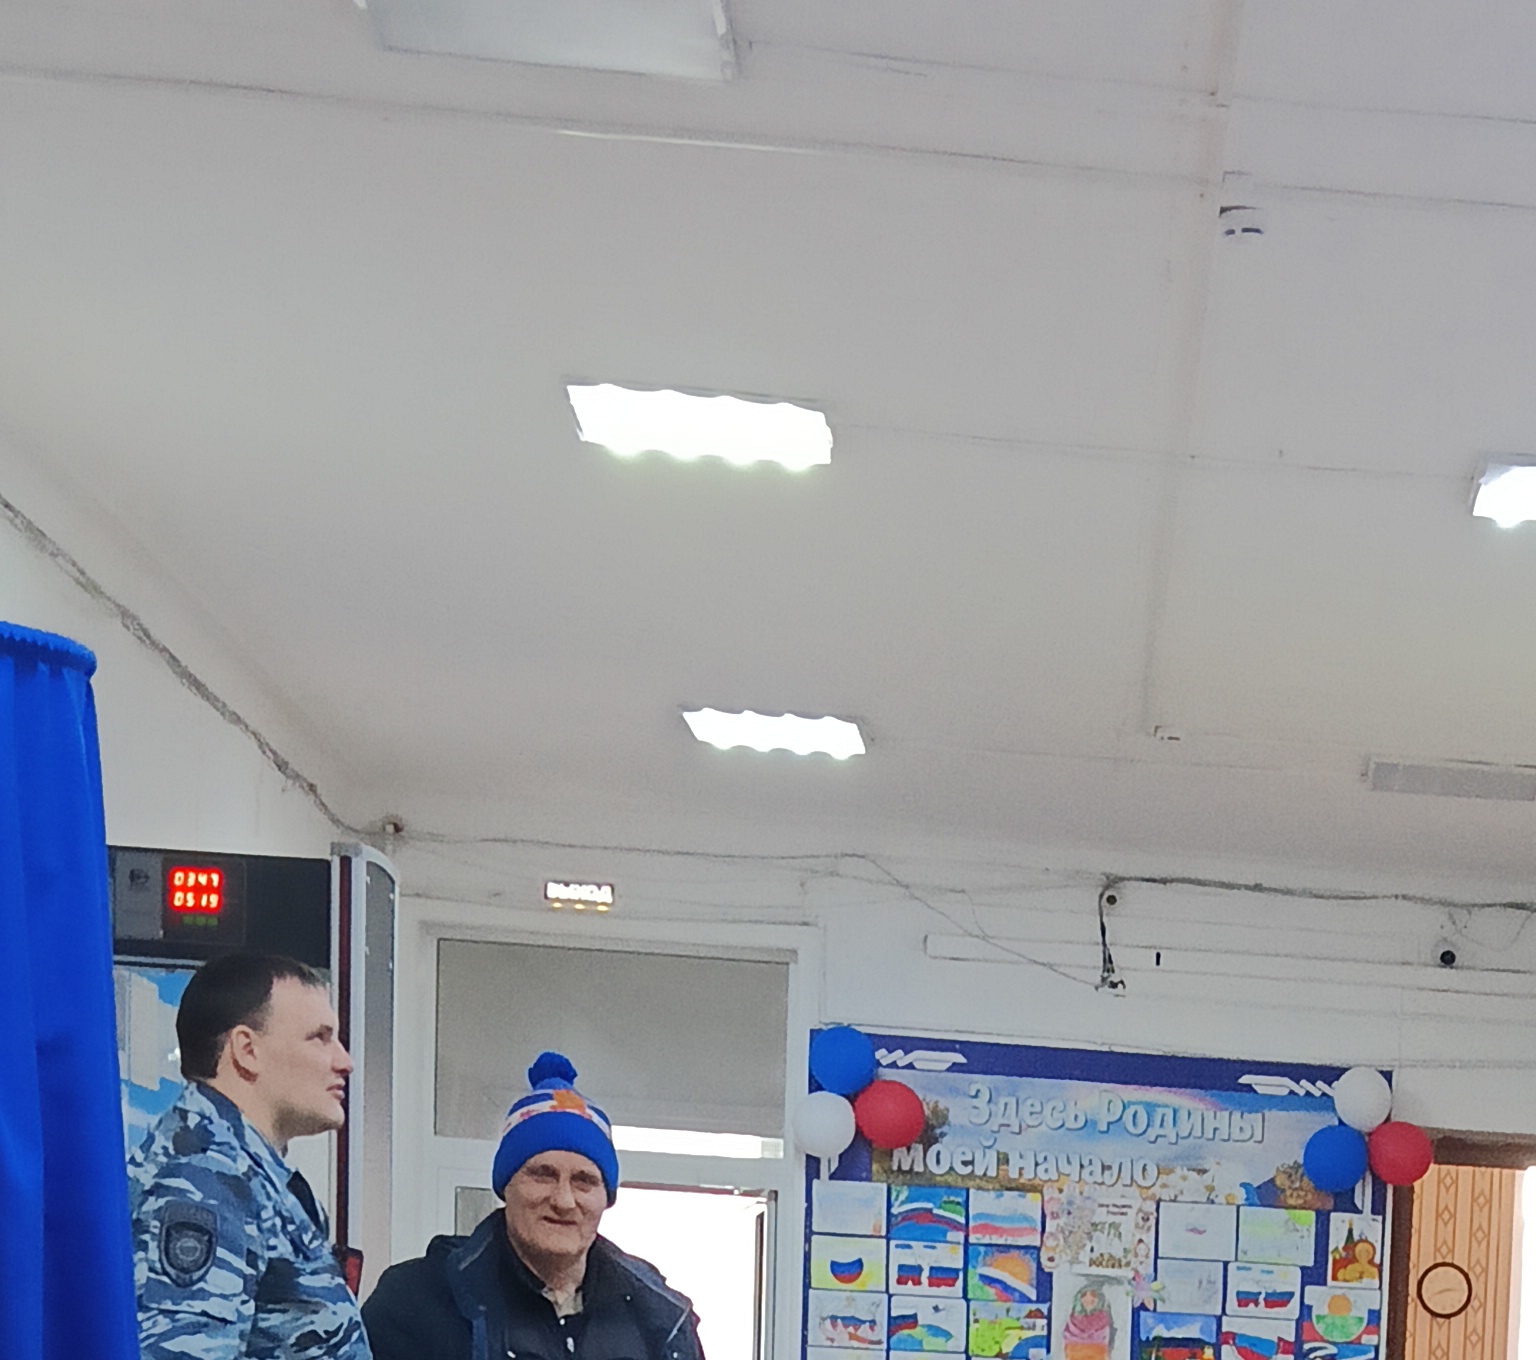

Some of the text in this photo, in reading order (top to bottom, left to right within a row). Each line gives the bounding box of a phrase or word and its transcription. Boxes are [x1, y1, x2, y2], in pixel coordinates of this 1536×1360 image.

[967, 1081, 1266, 1144] Здесь Родины
[891, 1135, 1160, 1187] моей начало
